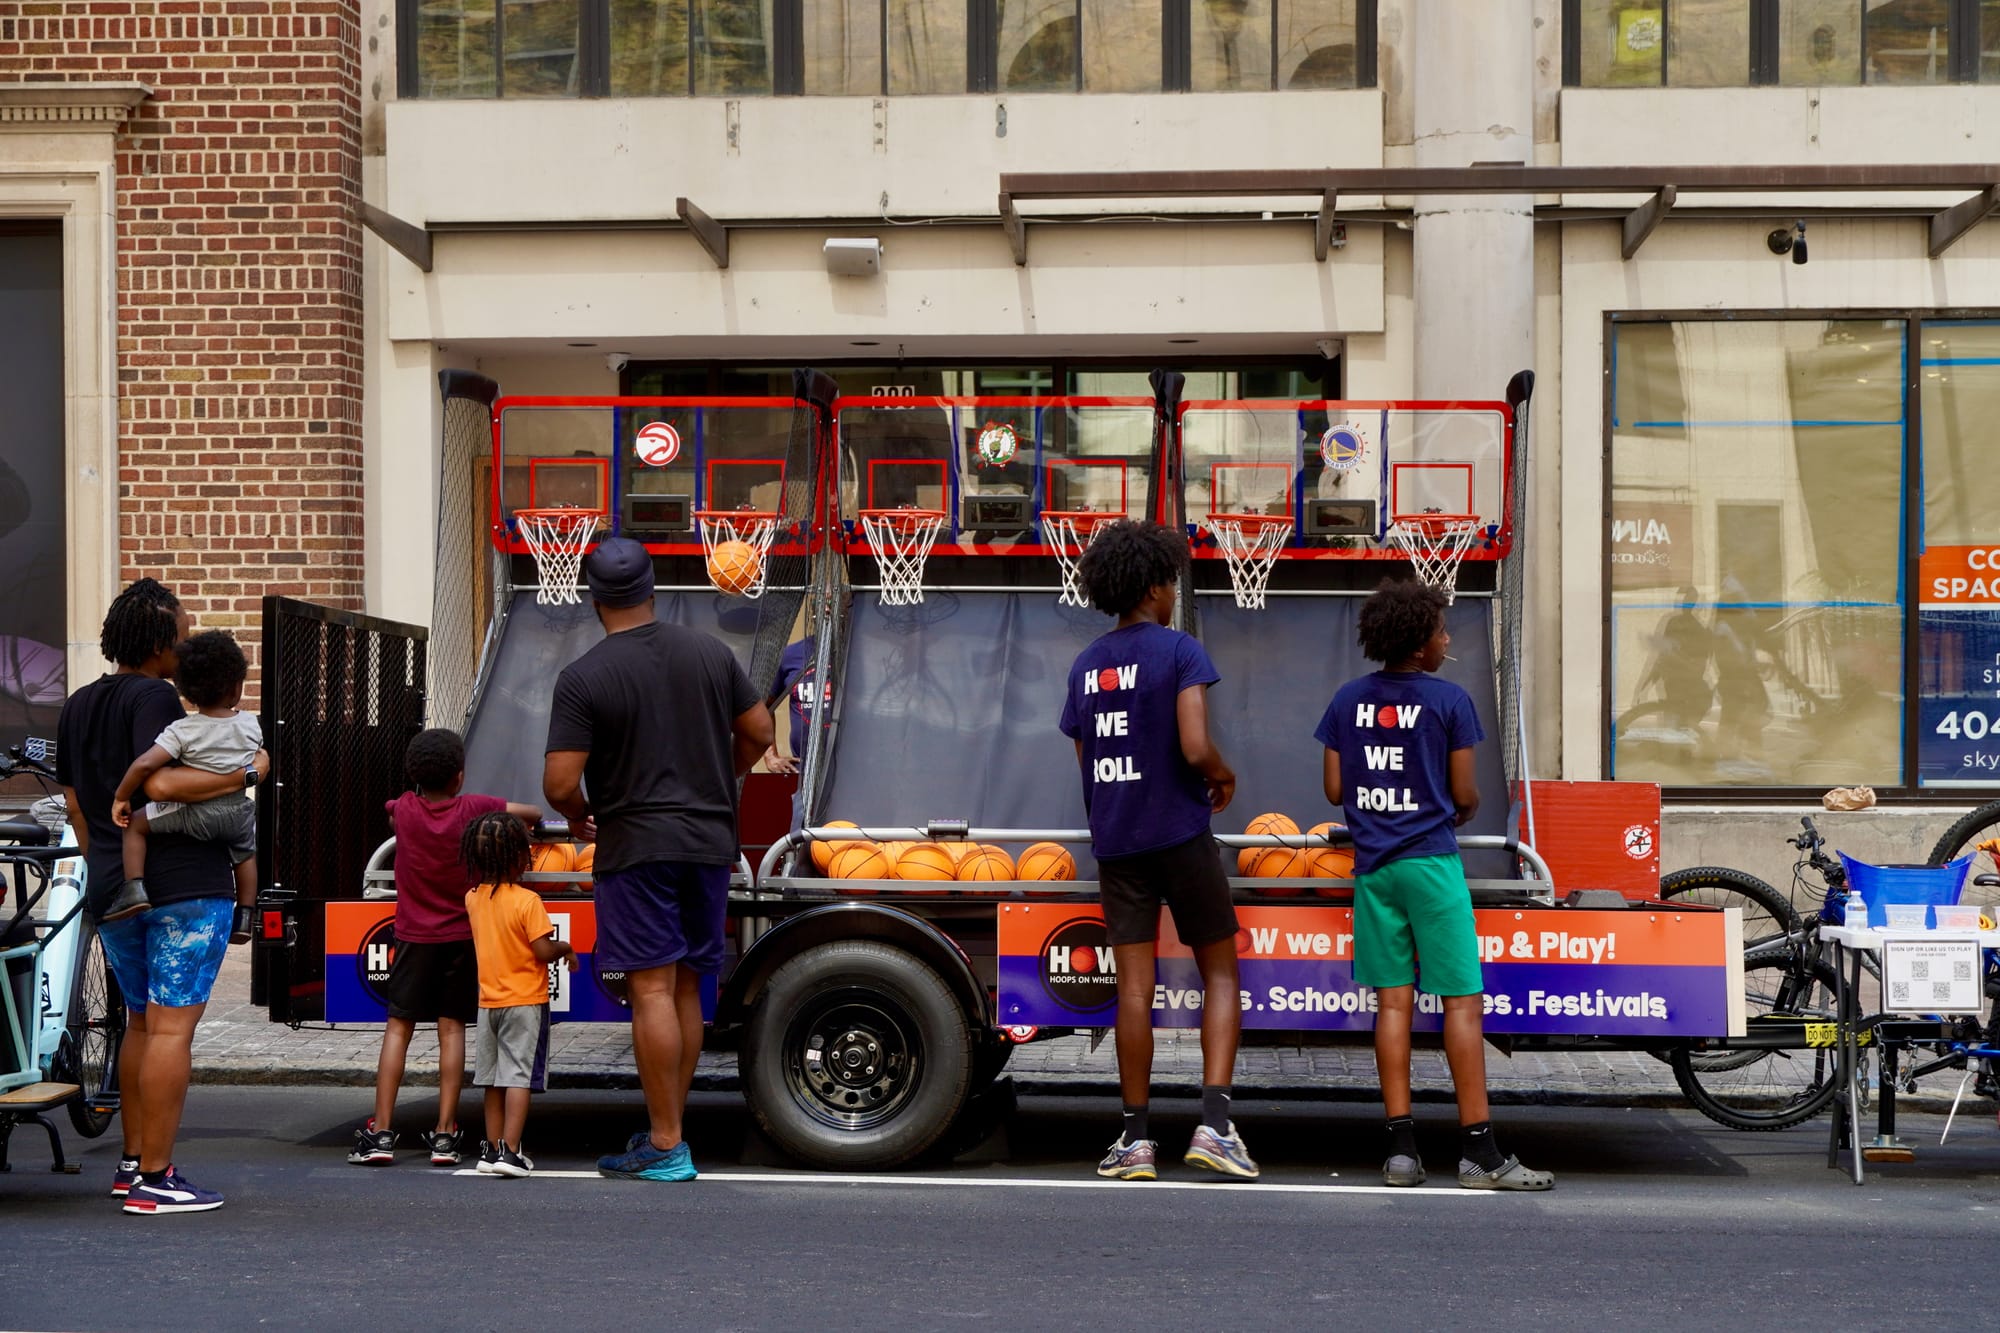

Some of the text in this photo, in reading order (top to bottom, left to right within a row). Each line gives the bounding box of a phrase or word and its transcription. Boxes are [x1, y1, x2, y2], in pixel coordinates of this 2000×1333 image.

[1084, 664, 1138, 695] HOW
[1356, 703, 1422, 729] HOW
[1364, 745, 1404, 771] WE
[1357, 786, 1419, 812] ROLL
[1286, 933, 1331, 955] we
[1509, 930, 1535, 959] &
[1540, 932, 1616, 964] Play!
[1049, 975, 1118, 985] HOOPS ON WHEEL
[1529, 989, 1667, 1017] Festivals
[1808, 1030, 1818, 1040] DO
